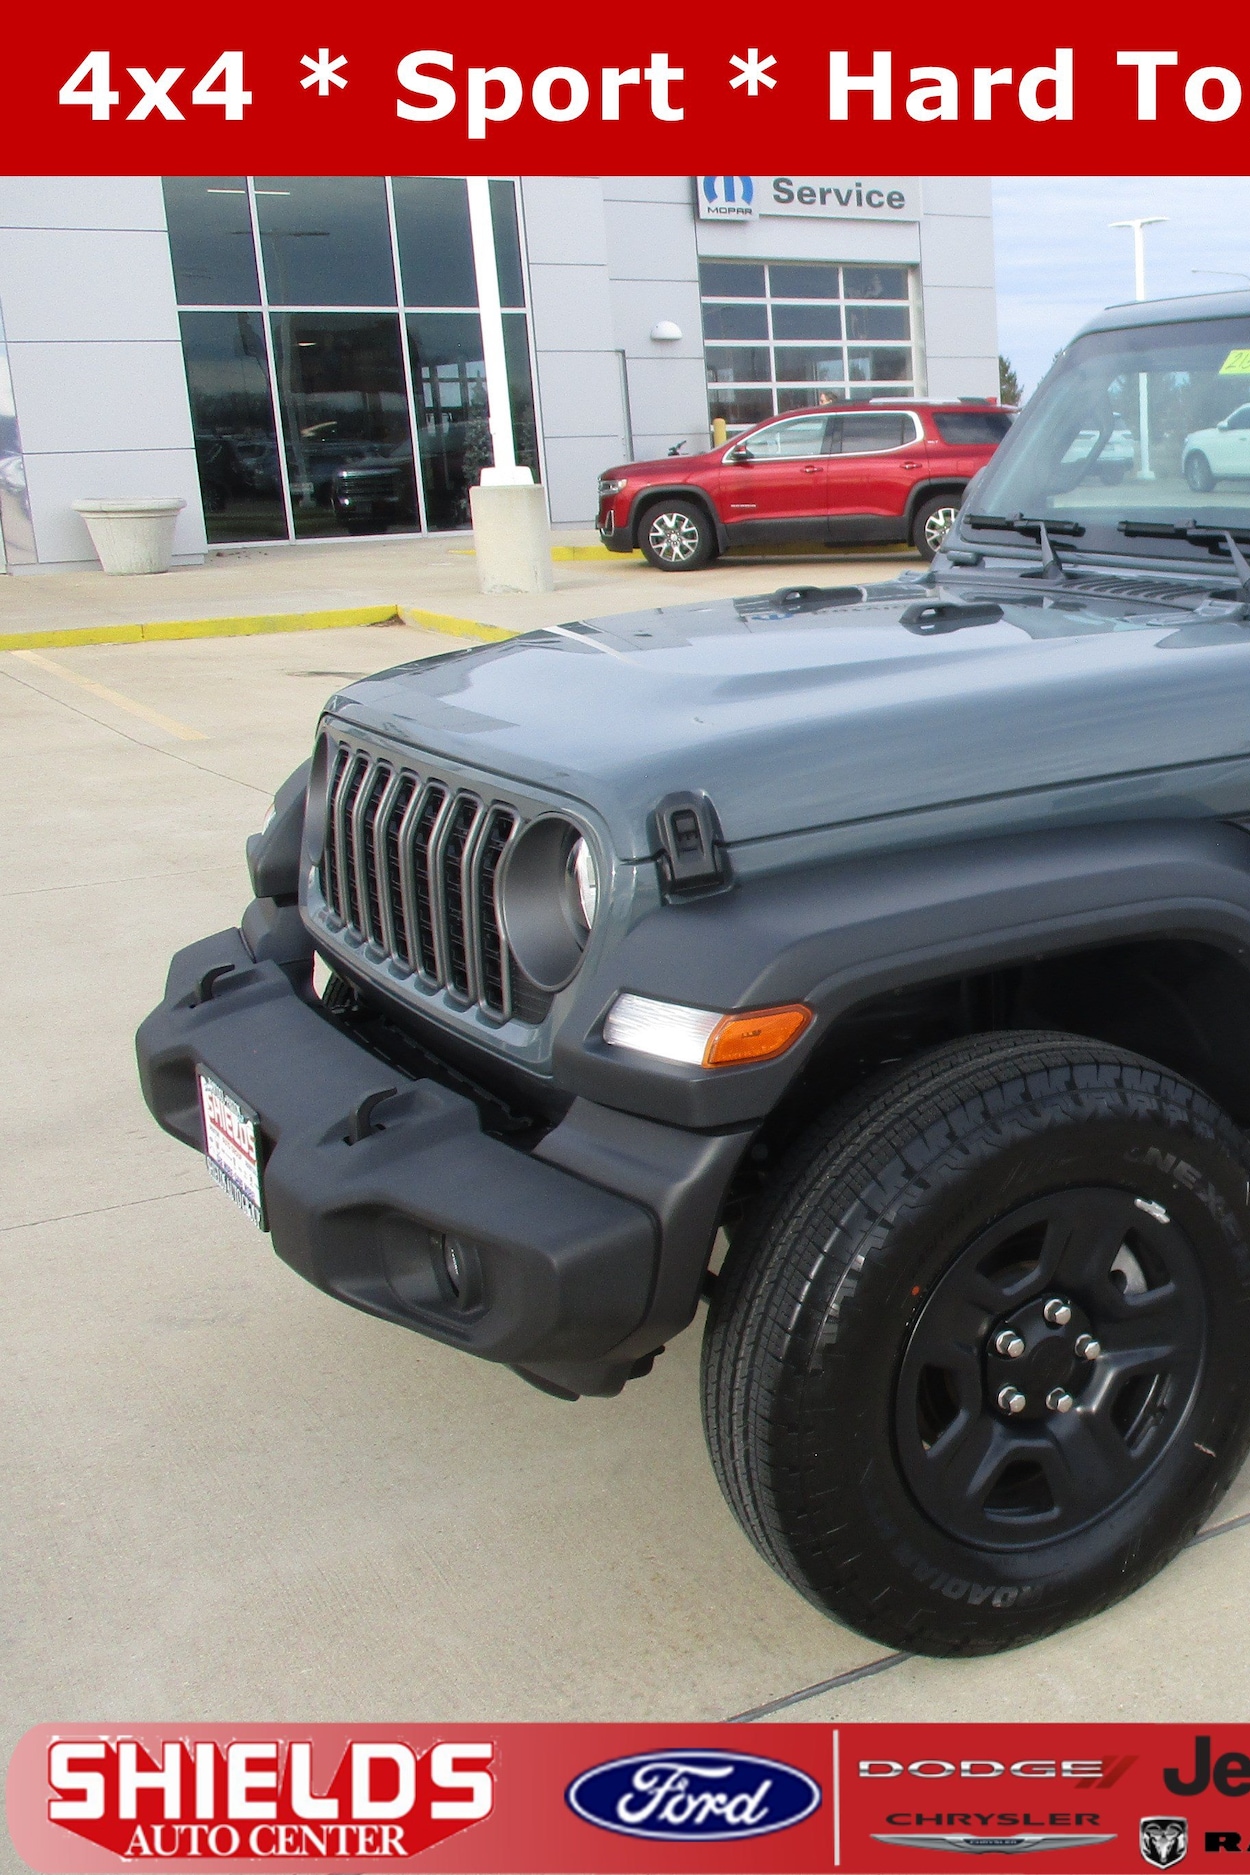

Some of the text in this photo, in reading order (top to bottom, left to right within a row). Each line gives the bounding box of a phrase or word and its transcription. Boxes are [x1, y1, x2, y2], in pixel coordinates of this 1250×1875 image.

[772, 176, 906, 210] Service
[707, 206, 753, 216] MOPAR
[207, 1094, 257, 1157] SHIELDS
